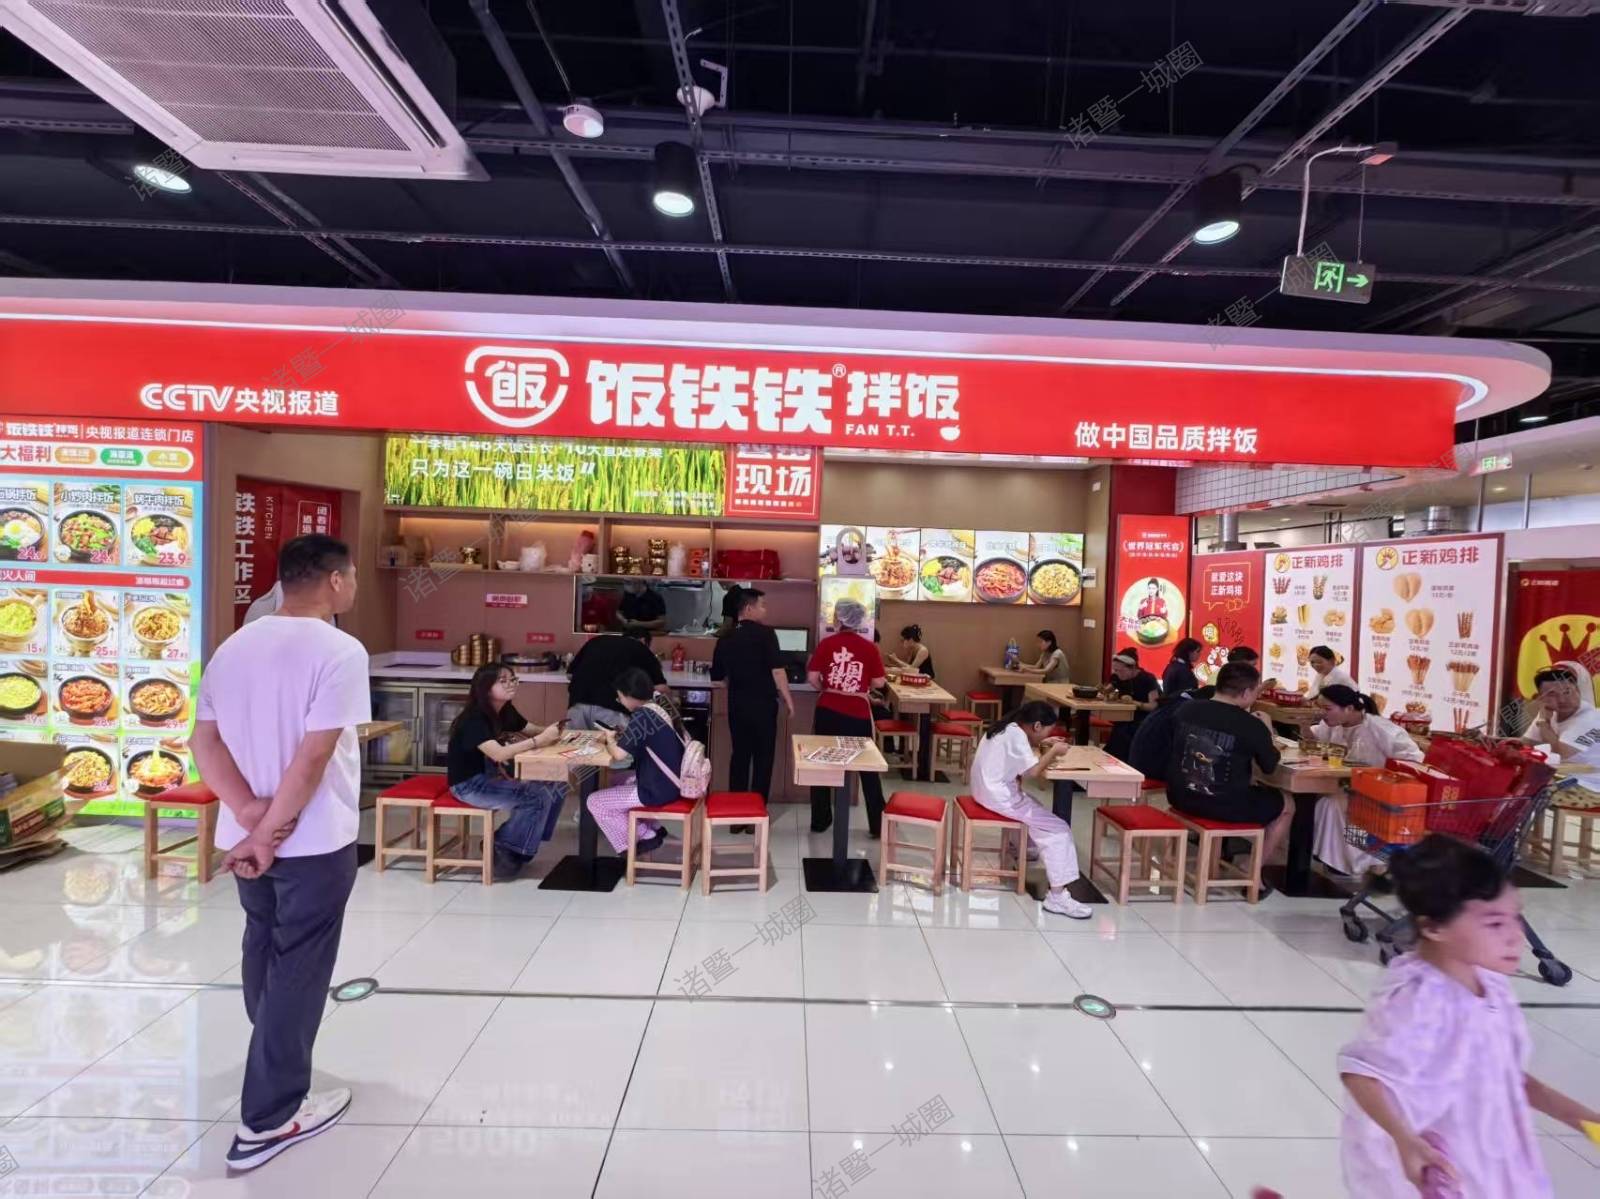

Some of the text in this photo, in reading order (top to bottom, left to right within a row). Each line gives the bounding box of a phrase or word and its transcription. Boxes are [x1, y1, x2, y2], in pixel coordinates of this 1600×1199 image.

[140, 383, 234, 412] CCTV
[86, 426, 194, 443] 央视报道连锁门店
[845, 423, 879, 436] FAN
[1075, 421, 1258, 454] 做中国品质拌饭
[735, 463, 811, 497] 现场
[264, 496, 275, 540] KITCHEN
[234, 492, 256, 605] 铁铁工作区
[1292, 554, 1344, 569] 正新鸡排
[1402, 546, 1479, 566] 正新鸡排
